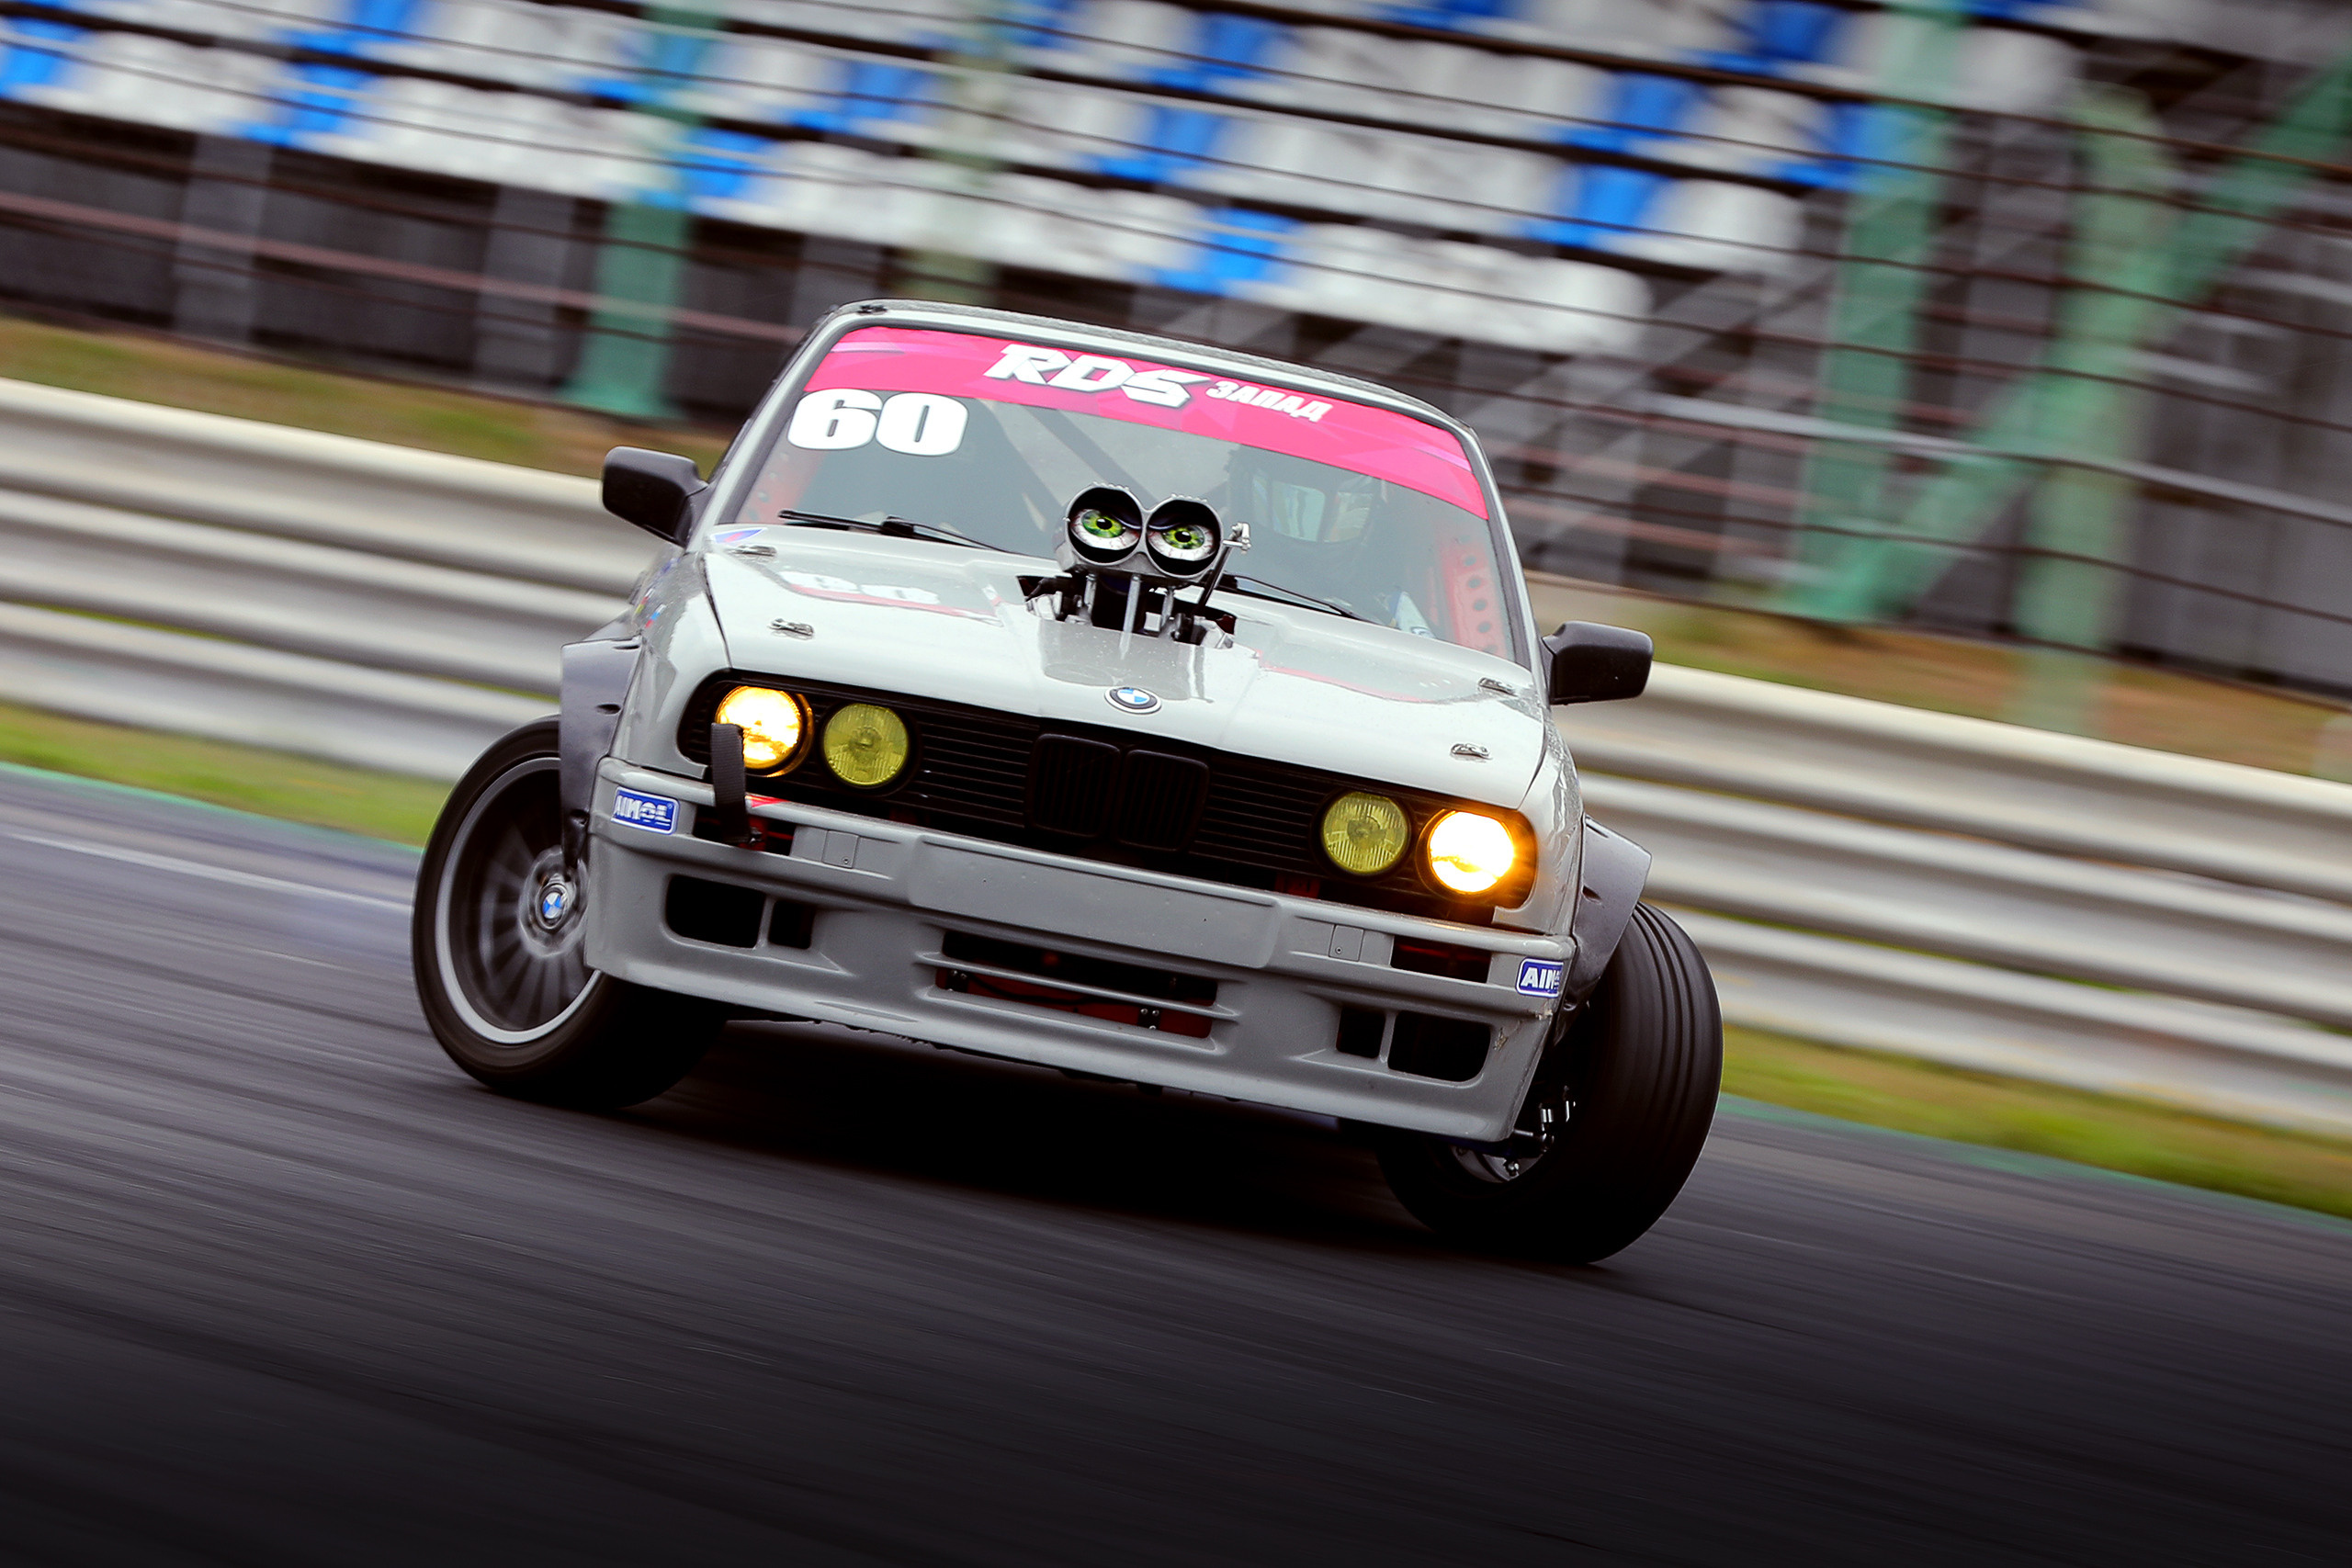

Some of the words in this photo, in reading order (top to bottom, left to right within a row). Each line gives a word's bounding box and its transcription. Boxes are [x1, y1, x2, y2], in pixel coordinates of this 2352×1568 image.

[983, 344, 1211, 408] RDS
[1205, 380, 1333, 422] ЗАПАД
[787, 389, 968, 456] 60
